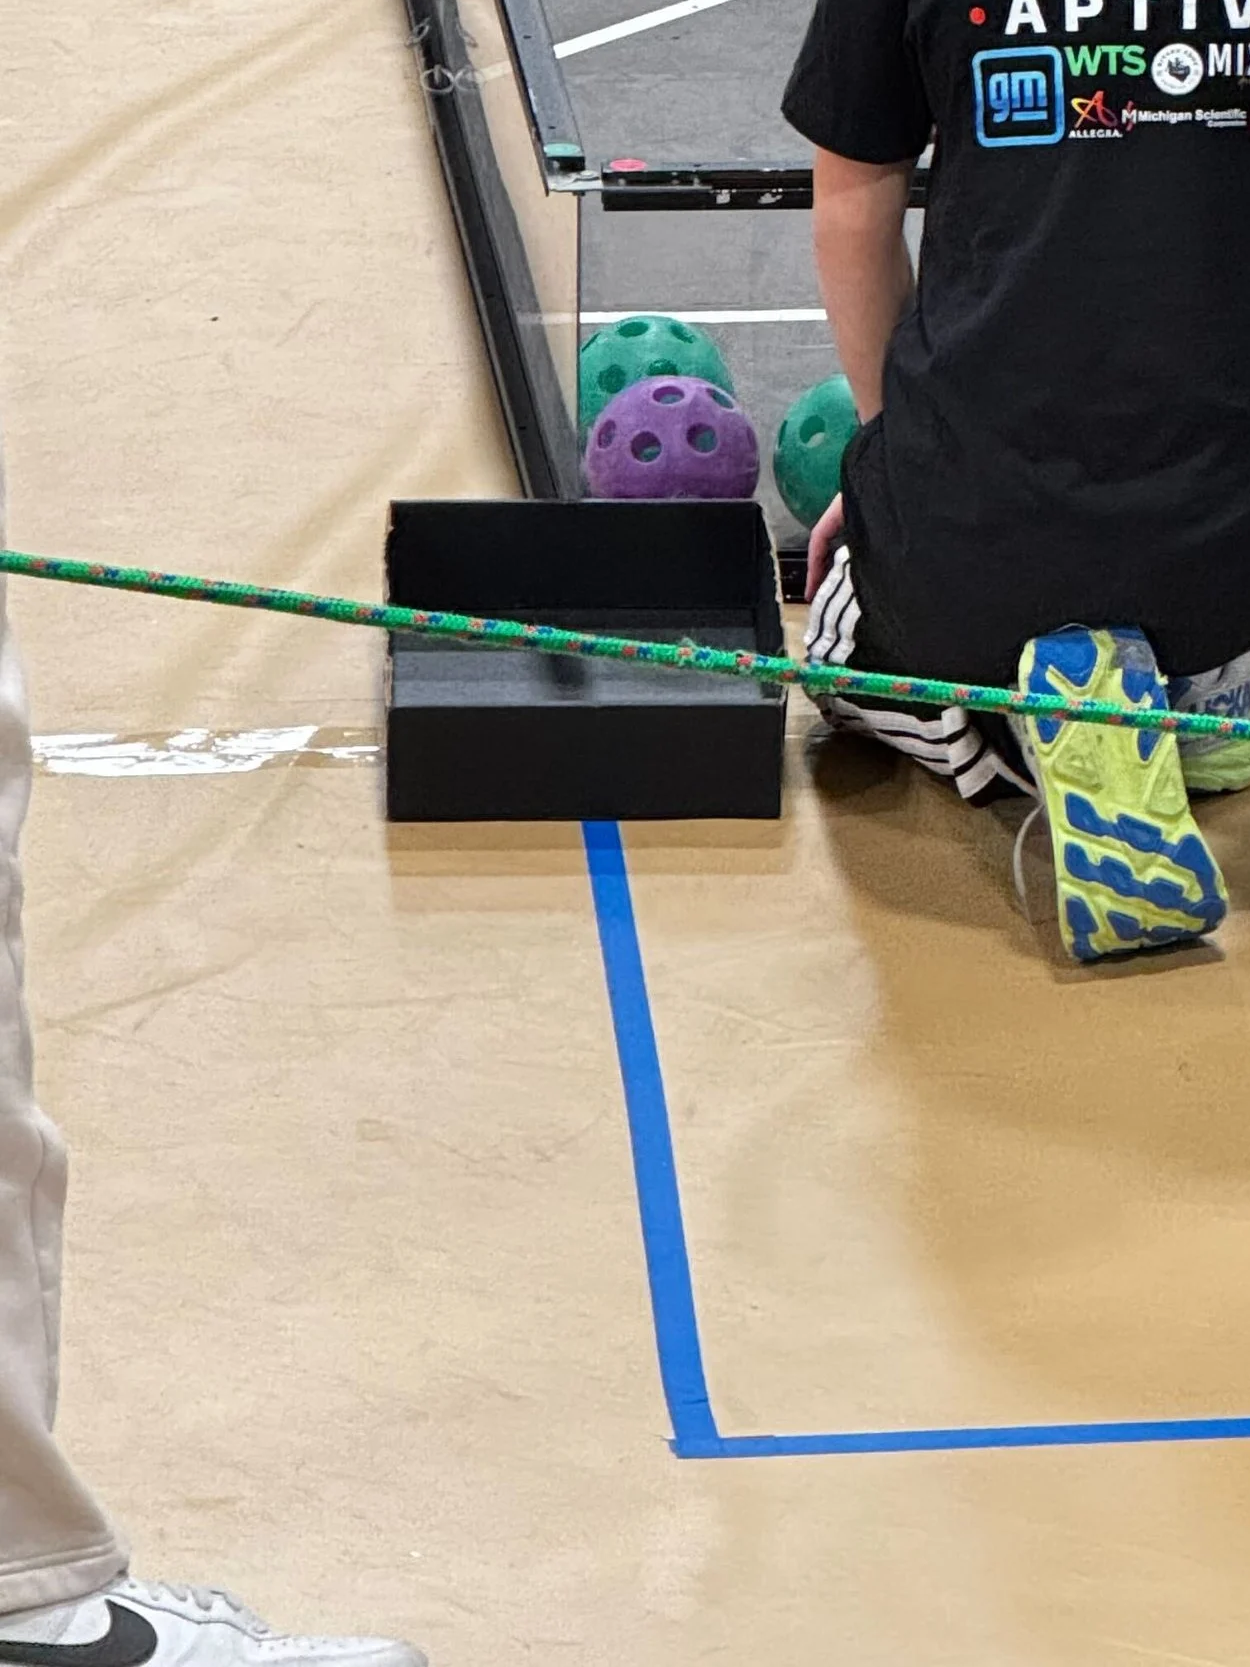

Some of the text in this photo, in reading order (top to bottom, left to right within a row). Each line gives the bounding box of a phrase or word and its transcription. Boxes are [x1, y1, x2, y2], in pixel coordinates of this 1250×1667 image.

[1064, 44, 1146, 77] WTS
[987, 70, 1048, 124] gm
[1138, 109, 1193, 124] Michigan
[1195, 108, 1247, 121] Scientific
